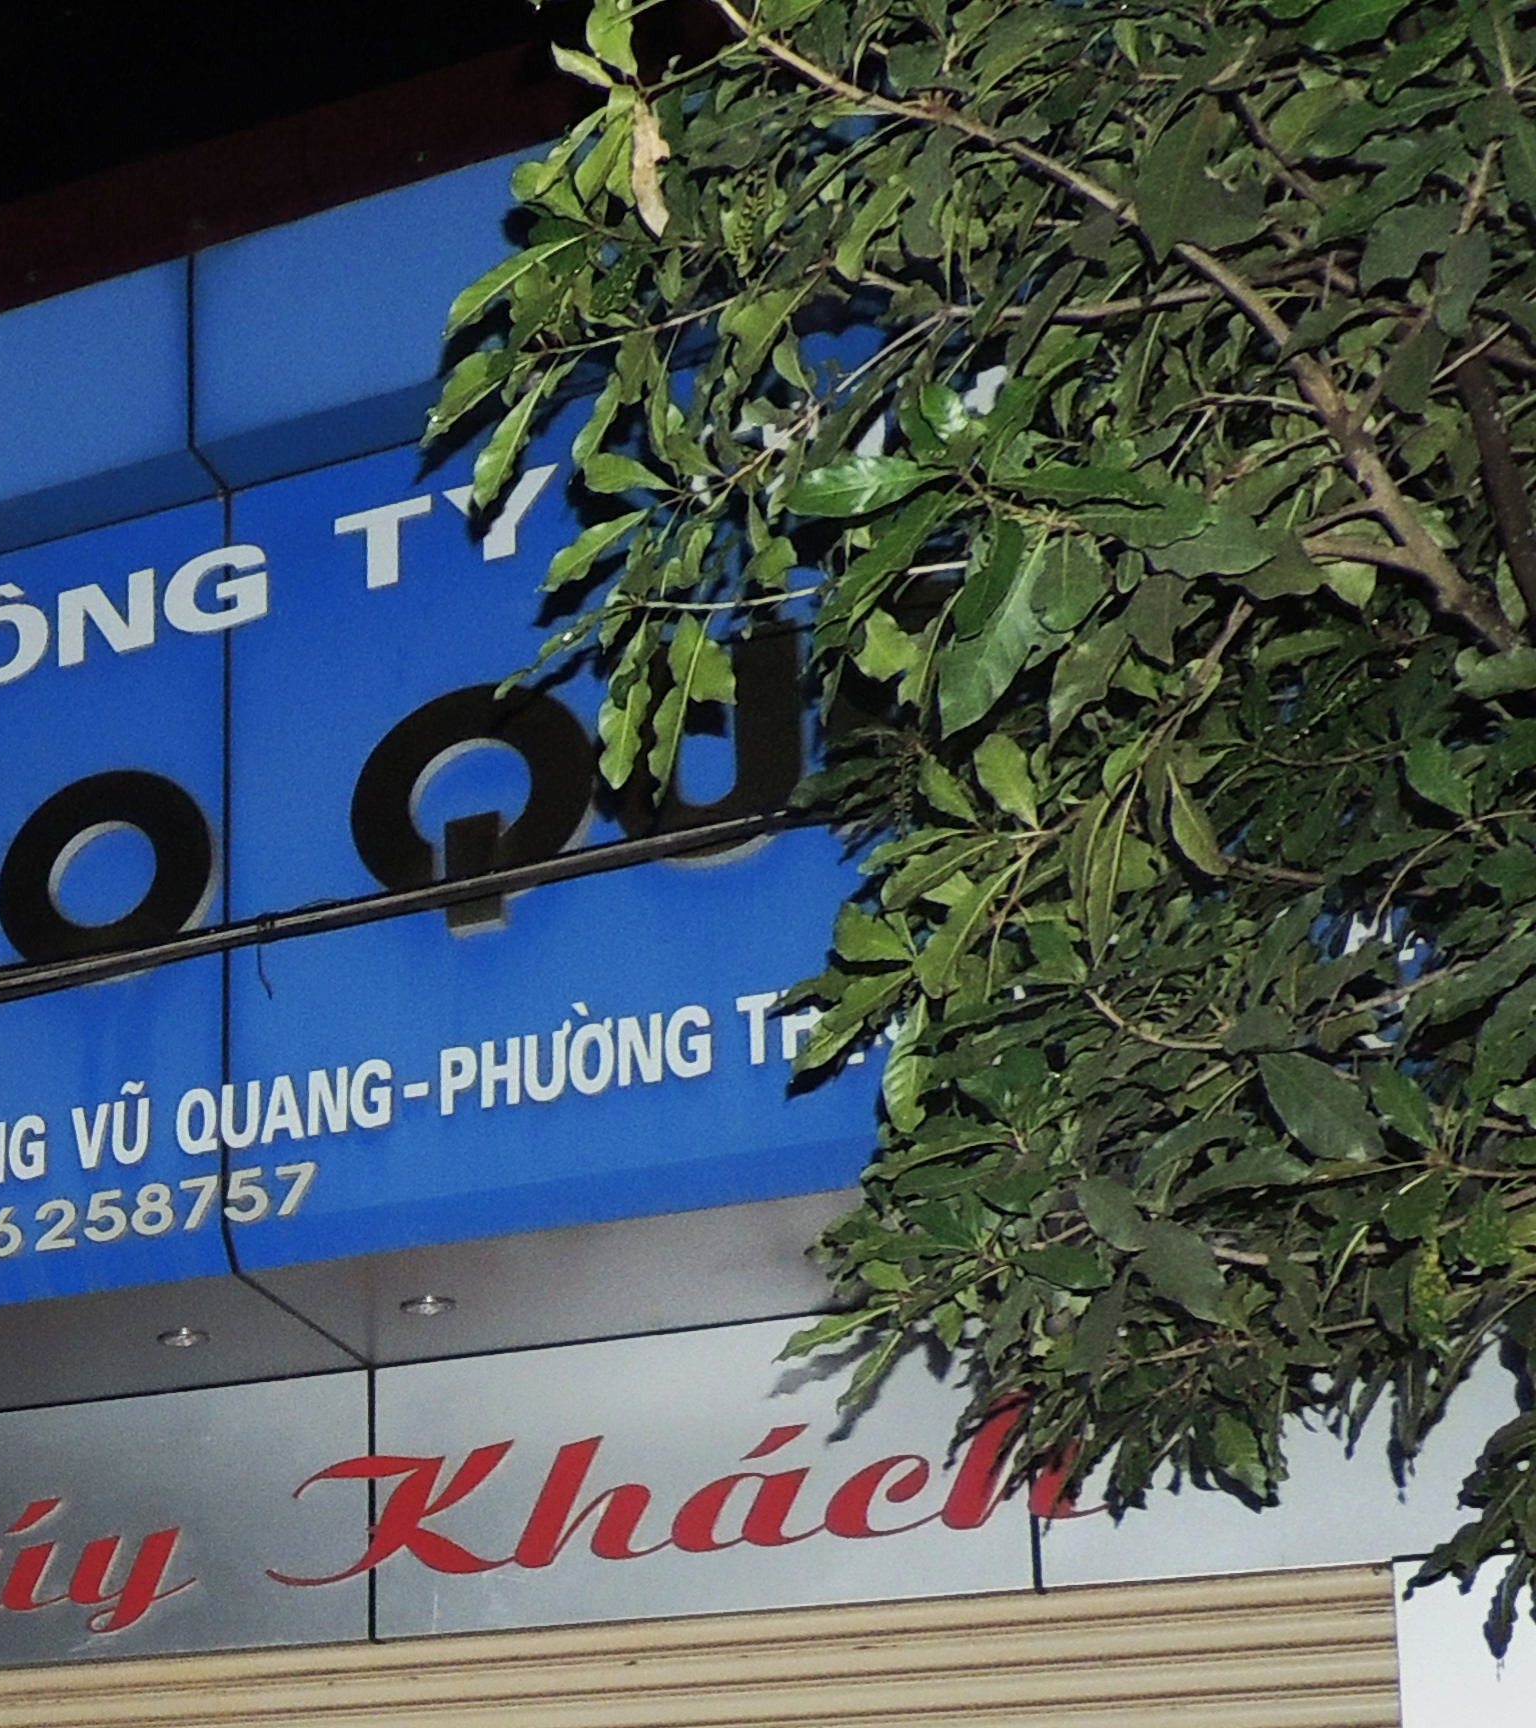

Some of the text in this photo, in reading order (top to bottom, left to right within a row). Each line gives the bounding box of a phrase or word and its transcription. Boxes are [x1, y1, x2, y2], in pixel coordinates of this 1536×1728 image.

[334, 464, 559, 590] TY
[350, 620, 808, 936] QU
[71, 1080, 151, 1170] VŨ
[266, 1386, 1112, 1588] Khách
